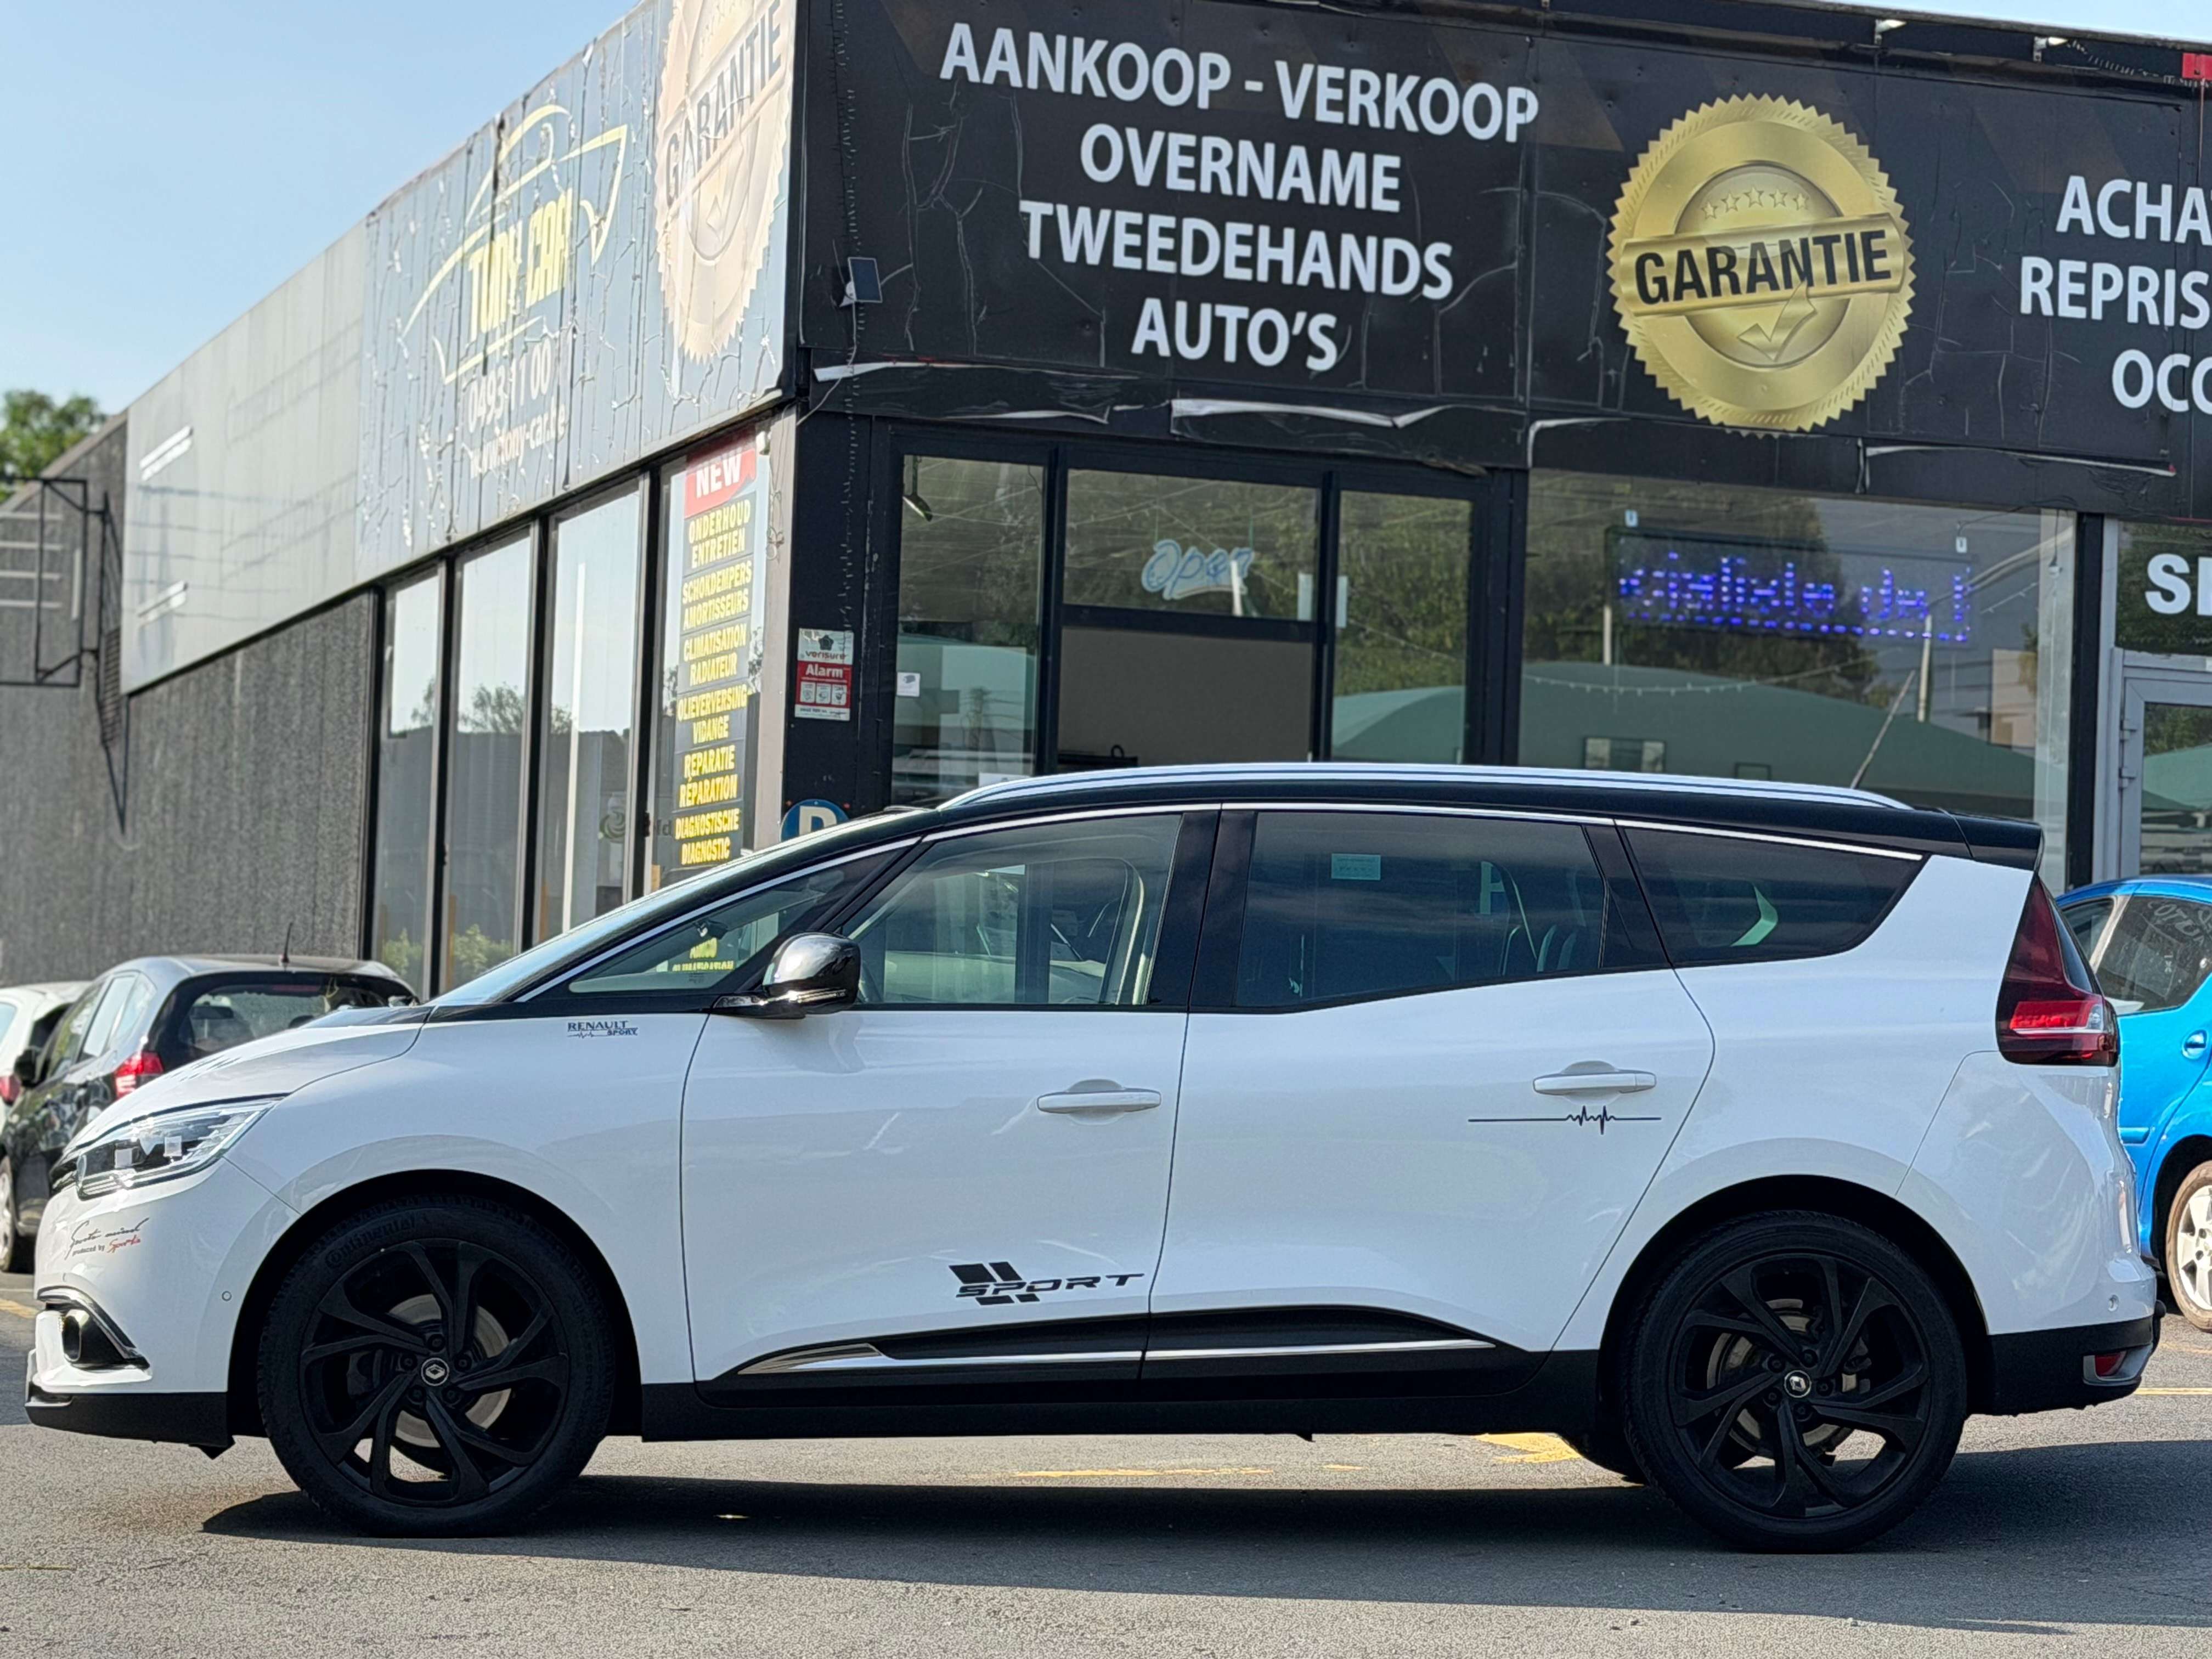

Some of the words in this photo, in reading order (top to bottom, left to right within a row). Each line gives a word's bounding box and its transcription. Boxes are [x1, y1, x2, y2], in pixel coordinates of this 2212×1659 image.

[665, 0, 781, 209] GARANTIE
[940, 22, 1231, 109] AANKOOP
[1275, 60, 1539, 143] VERKOOP
[1080, 123, 1401, 212] OVERNAME
[2056, 175, 2212, 246] ACHA
[1019, 200, 1453, 300] TWEEDEHANDS
[1634, 229, 1893, 305] GARANTIE
[469, 219, 522, 342] TONY
[2020, 256, 2210, 329] REPRIS
[1131, 297, 1337, 371] AUTO'S
[2112, 349, 2212, 415] OCC
[696, 452, 742, 499] NEW
[688, 499, 751, 544] ONDERHOUD
[691, 527, 746, 569] ENTRETIEN
[682, 560, 752, 605] SCHOKDEMPERS
[683, 588, 749, 631] AMORTISSEURS
[683, 623, 747, 662] CLIMATISATION
[689, 652, 738, 686] RADIATEUR
[805, 663, 844, 679] Alarm
[678, 684, 748, 722] OLIEVERVERSING
[692, 714, 730, 744] VIDANGE
[684, 745, 736, 778] REPARATIE
[675, 808, 740, 840] DIAGNOSTISCHE
[681, 836, 731, 866] DIAGNOSTIC
[567, 1020, 629, 1032] RENAULT
[607, 1027, 638, 1036] SPORT
[956, 1273, 1146, 1299] SPORT
